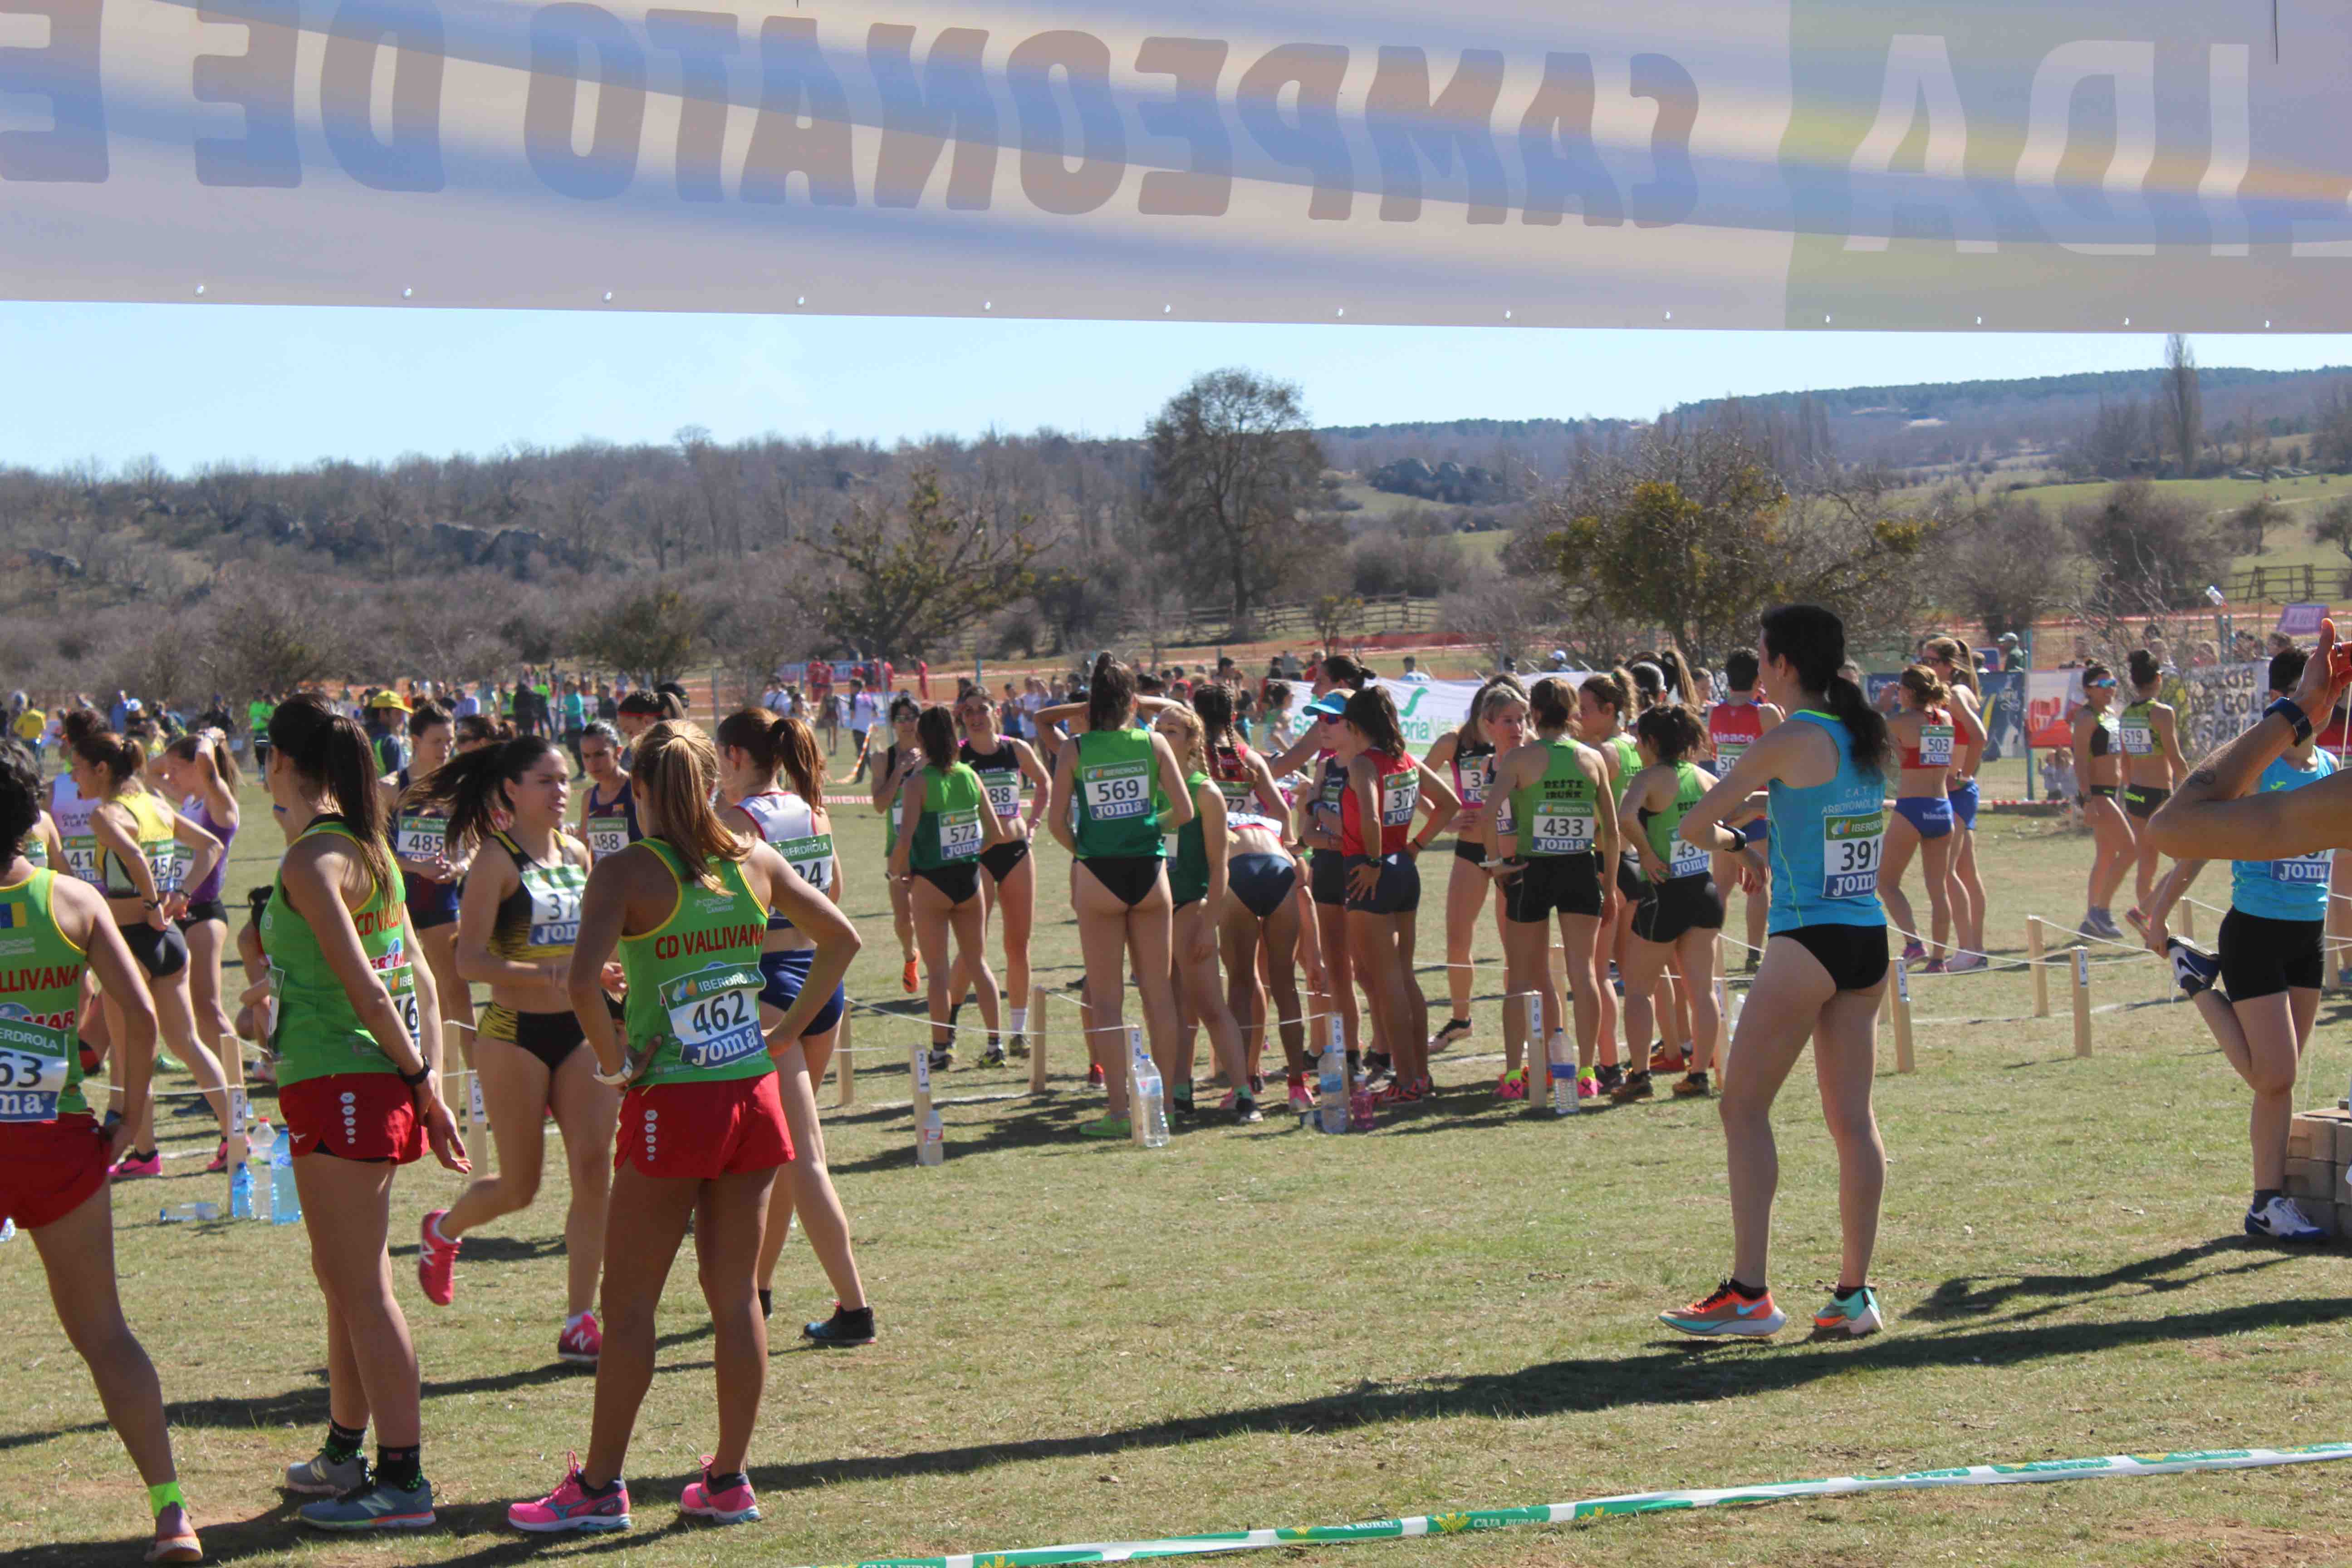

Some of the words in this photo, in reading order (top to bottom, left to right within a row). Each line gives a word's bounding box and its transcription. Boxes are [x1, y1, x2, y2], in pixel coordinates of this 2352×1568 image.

[1928, 738, 1950, 752] 503
[1097, 779, 1140, 802] 569
[951, 824, 977, 843] 572
[1544, 818, 1584, 837] 433
[408, 833, 443, 852] 485
[1840, 838, 1879, 872] 391
[655, 935, 679, 960] CD
[698, 972, 760, 992] IBERDROLA
[693, 990, 750, 1036] 462
[1357, 1520, 1397, 1529] RURAL
[1473, 1518, 1502, 1528] CAJA
